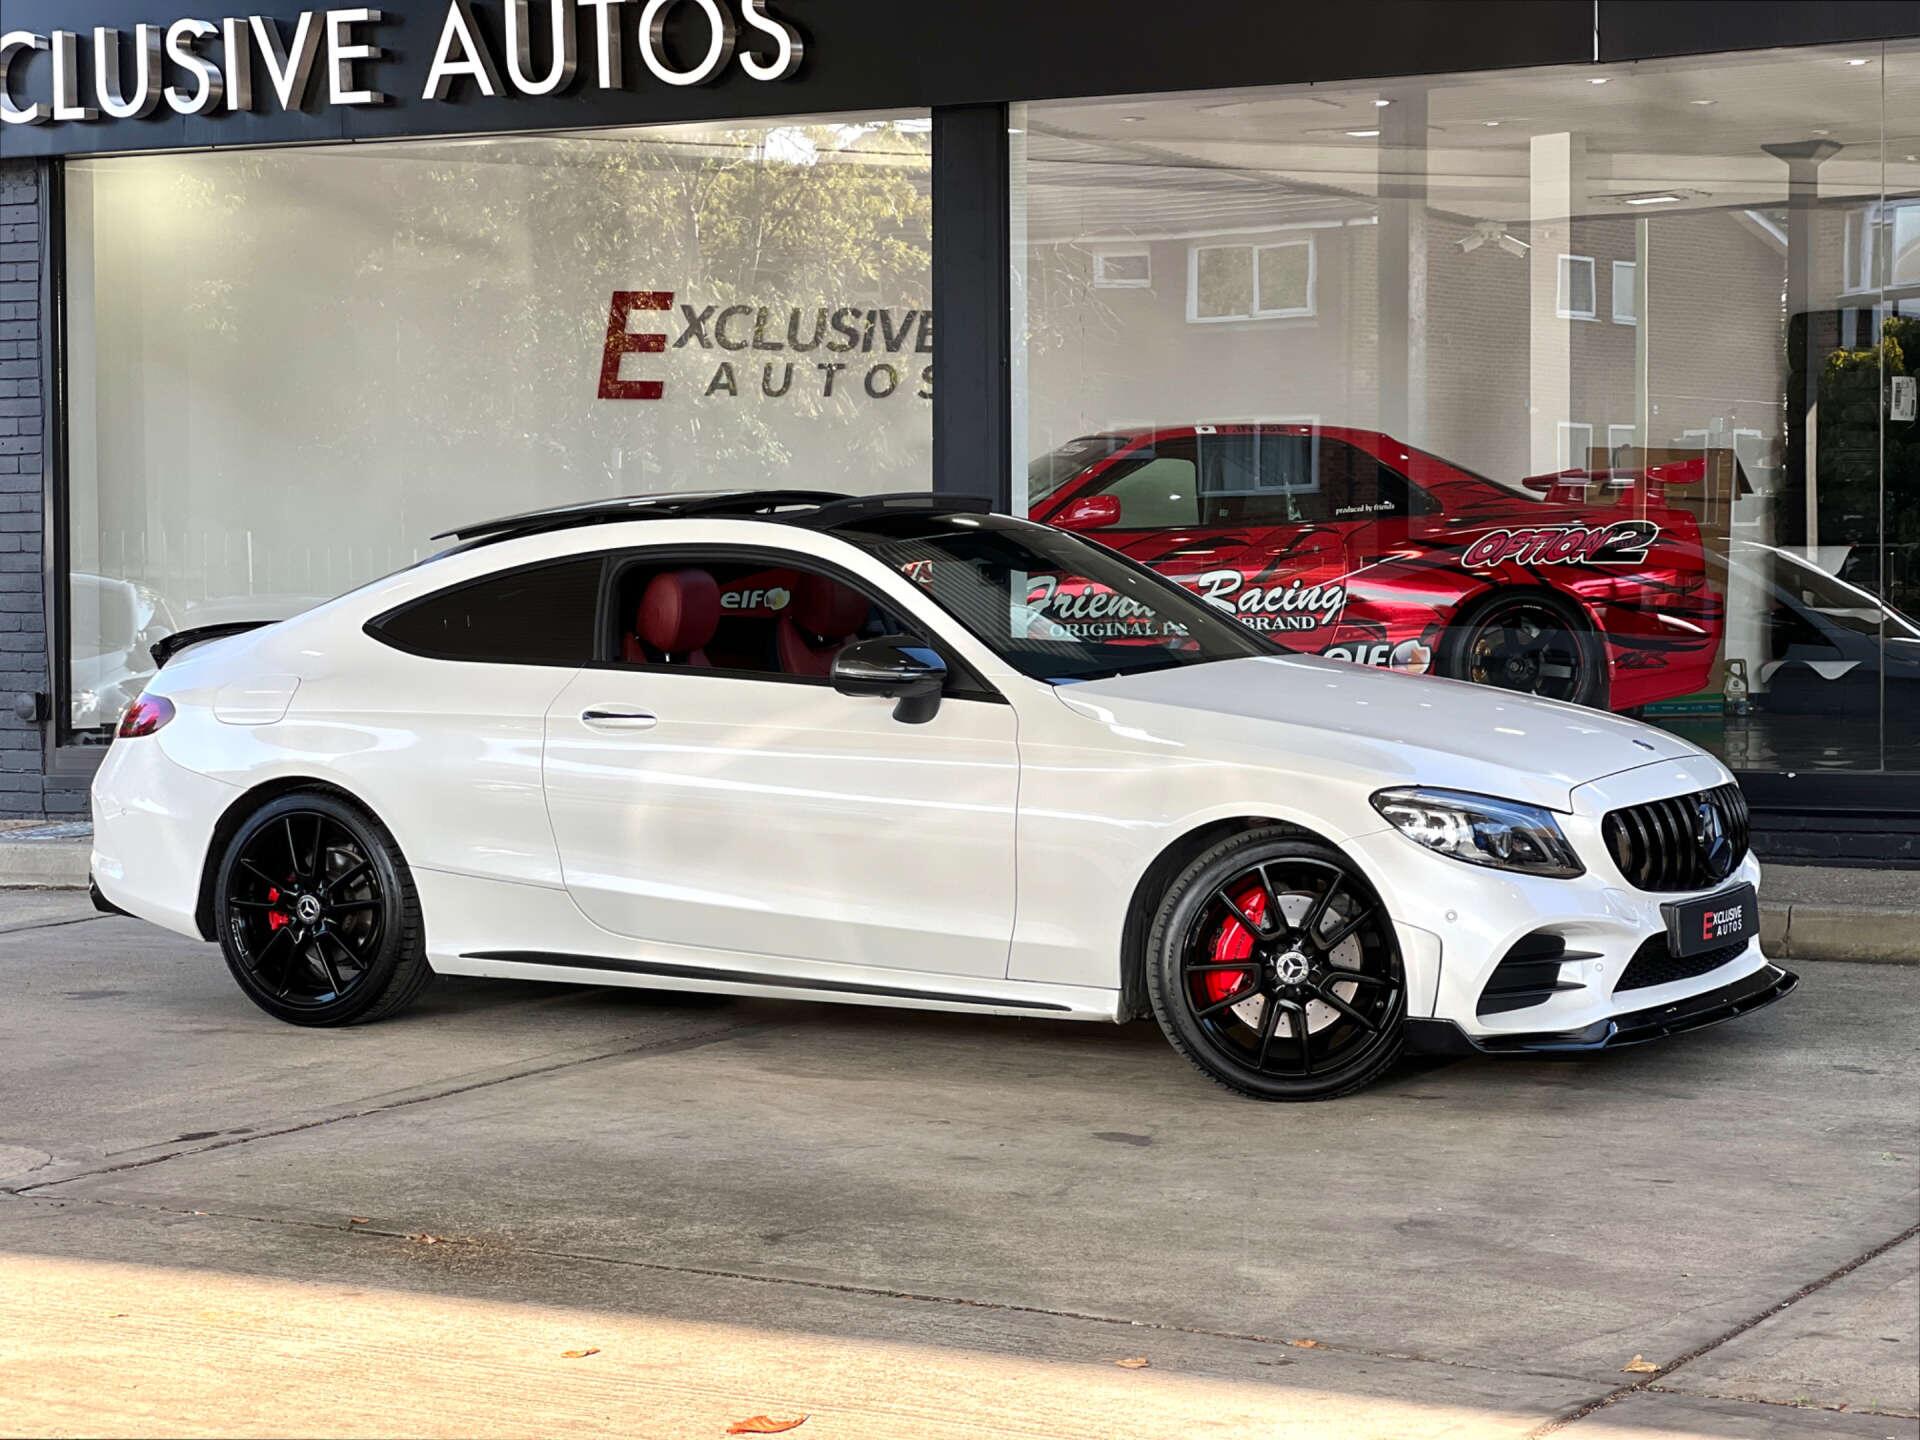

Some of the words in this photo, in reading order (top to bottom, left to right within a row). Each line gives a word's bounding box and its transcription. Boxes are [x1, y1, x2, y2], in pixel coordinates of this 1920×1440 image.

[0, 8, 384, 124] CLUSIVE
[422, 0, 804, 99] AUTOS
[1335, 505, 1364, 516] produced
[1365, 504, 1373, 512] by
[721, 590, 764, 608] elf
[1198, 570, 1346, 624] Racing
[1050, 621, 1159, 638] ORIGINAL
[1241, 616, 1315, 631] BRAND
[1703, 905, 1742, 940] EXCLUSIVE
[1717, 919, 1743, 936] AUTOS
